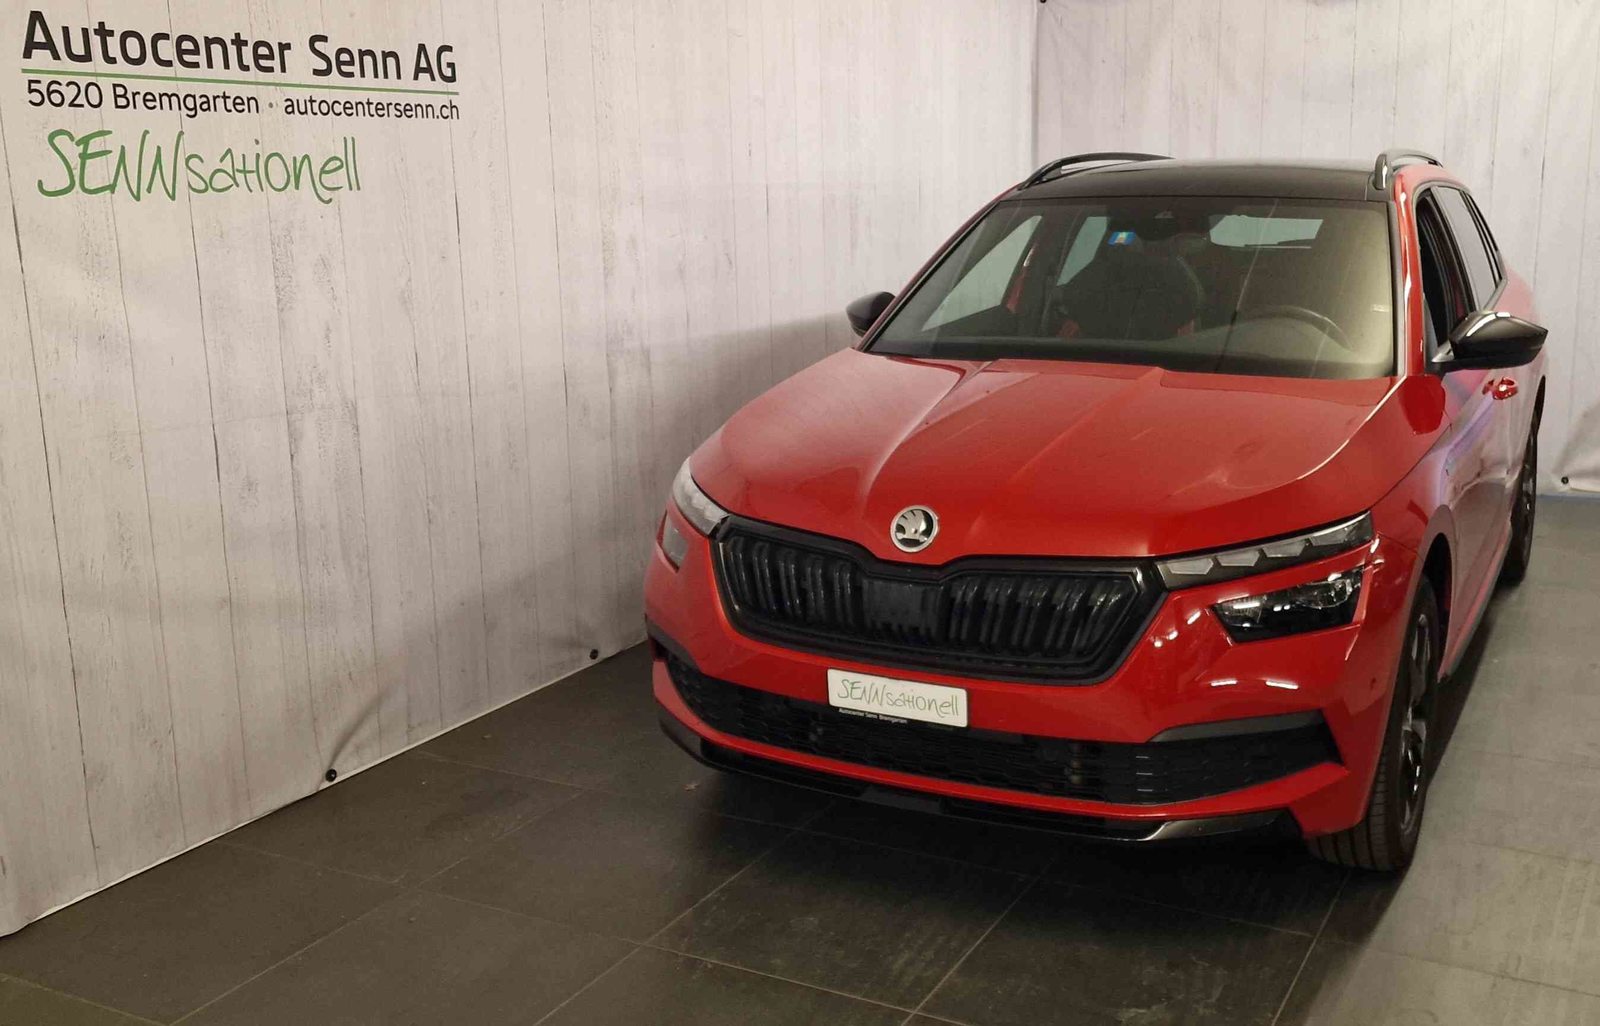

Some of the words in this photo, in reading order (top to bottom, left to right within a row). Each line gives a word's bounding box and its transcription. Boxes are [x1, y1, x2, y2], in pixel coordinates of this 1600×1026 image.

[22, 10, 291, 73] Autocenter
[308, 34, 402, 80] Senn
[412, 43, 457, 83] AG
[27, 79, 103, 109] 5620
[112, 83, 259, 118] Bremgarten
[284, 95, 460, 120] autocentersenn.ch
[37, 128, 361, 204] SENNsationell
[838, 679, 959, 718] SENNsationell
